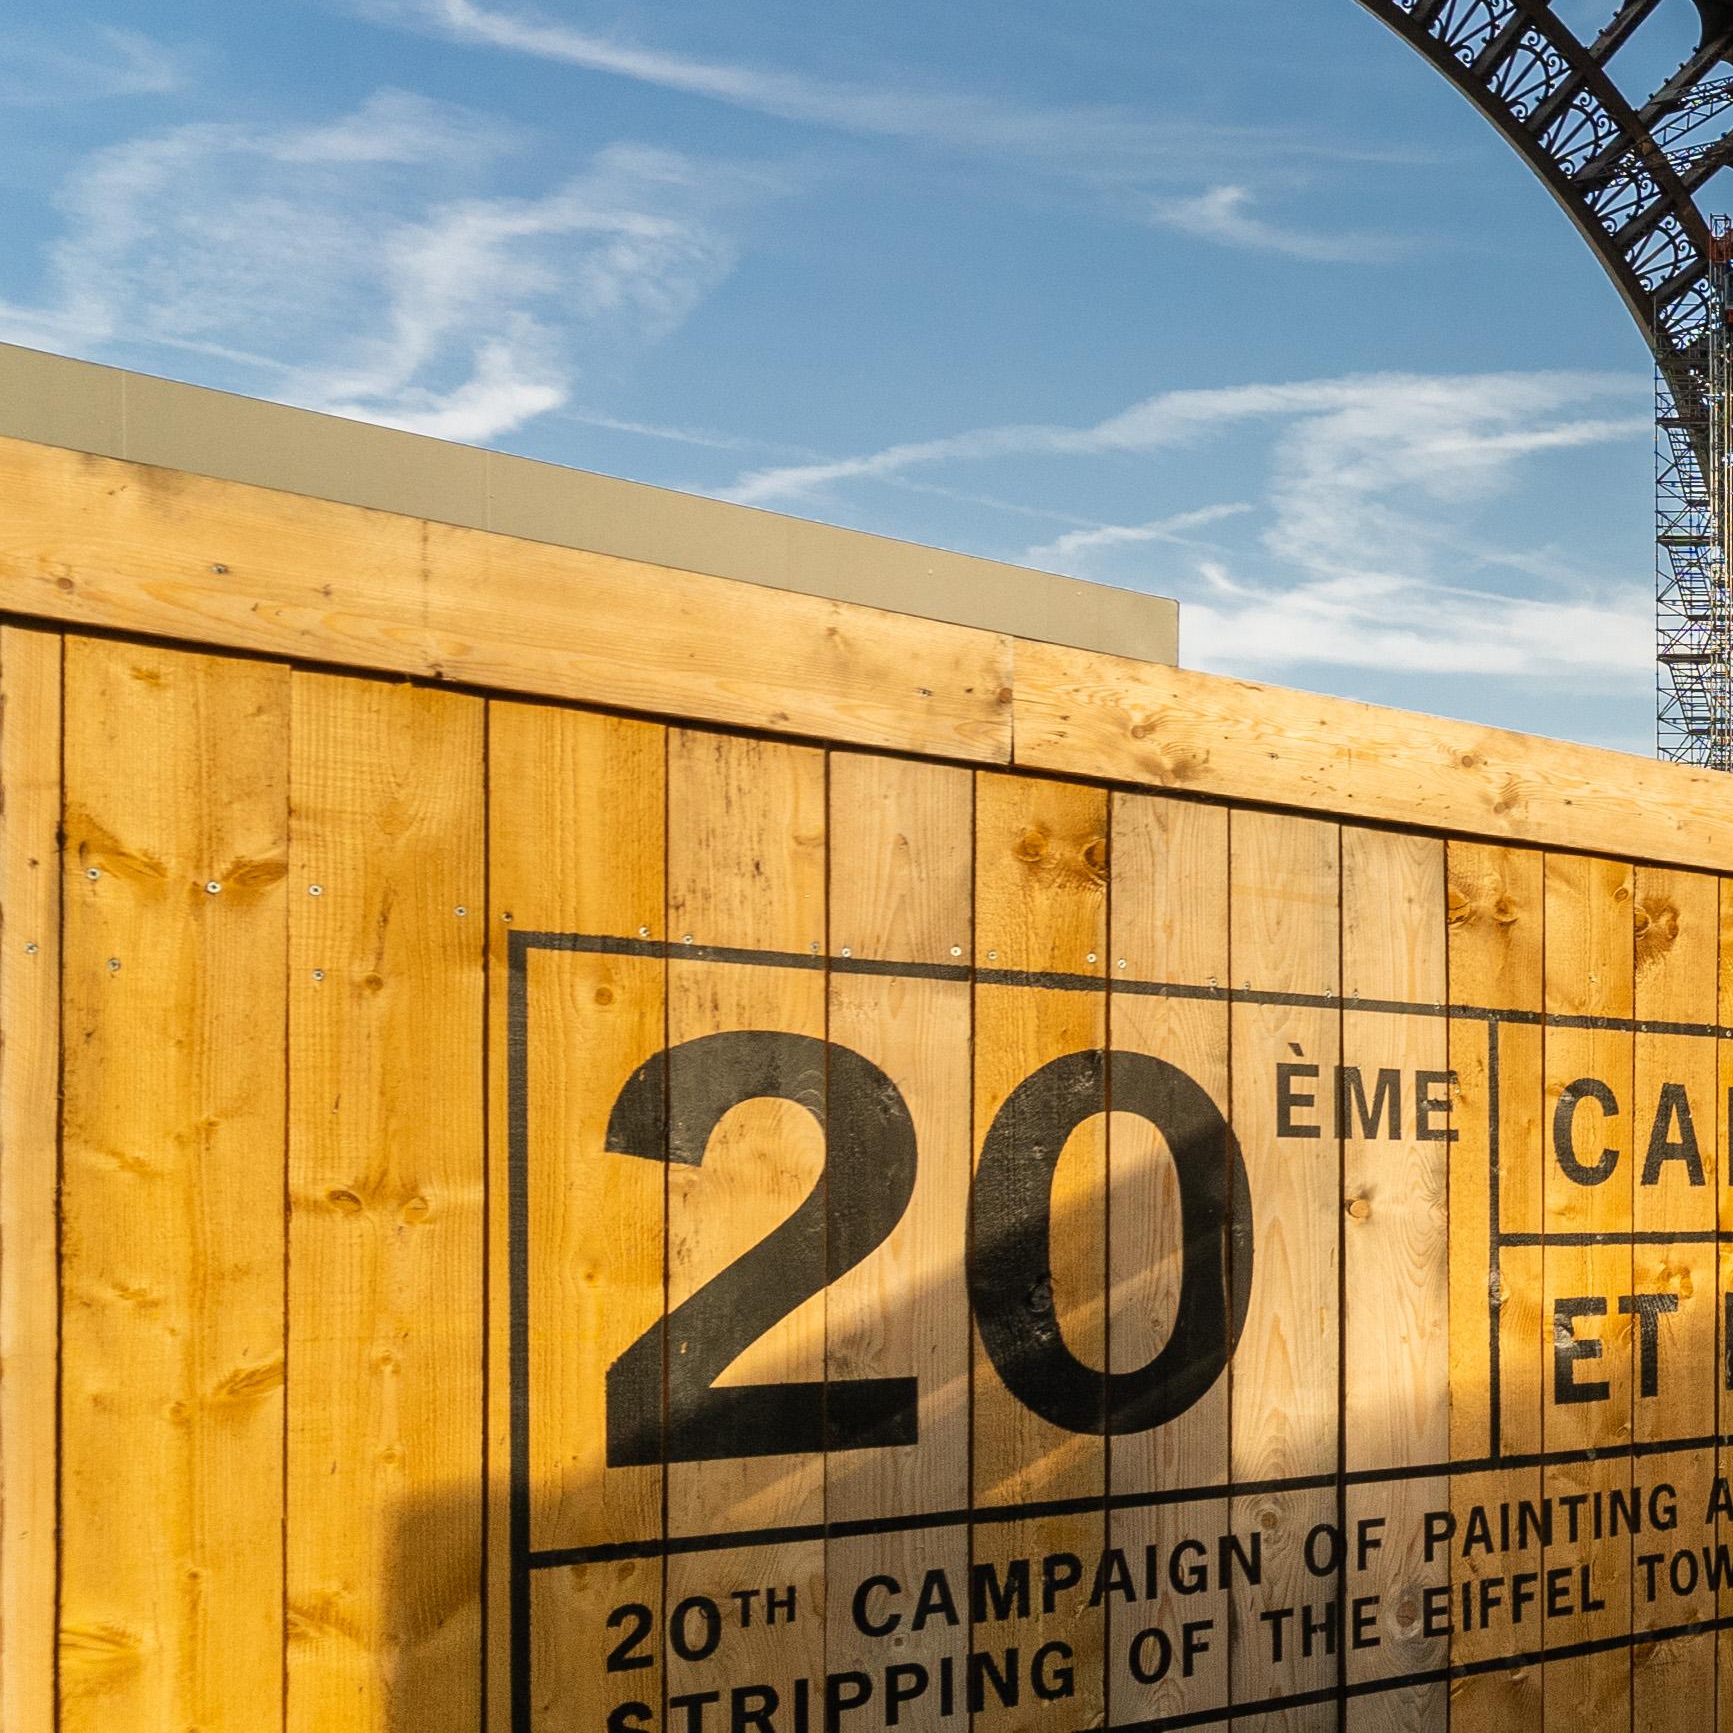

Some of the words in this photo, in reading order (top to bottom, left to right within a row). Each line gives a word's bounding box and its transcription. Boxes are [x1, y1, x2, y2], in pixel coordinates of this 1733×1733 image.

[1553, 1291, 1678, 1406] ET
[852, 1530, 1263, 1638] CAMPAIGN
[1304, 1517, 1386, 1577] OF
[1422, 1484, 1678, 1564] PAINTING
[1129, 1620, 1216, 1686] OF
[1261, 1594, 1381, 1665] THE
[1422, 1566, 1607, 1638] EIFFEL
